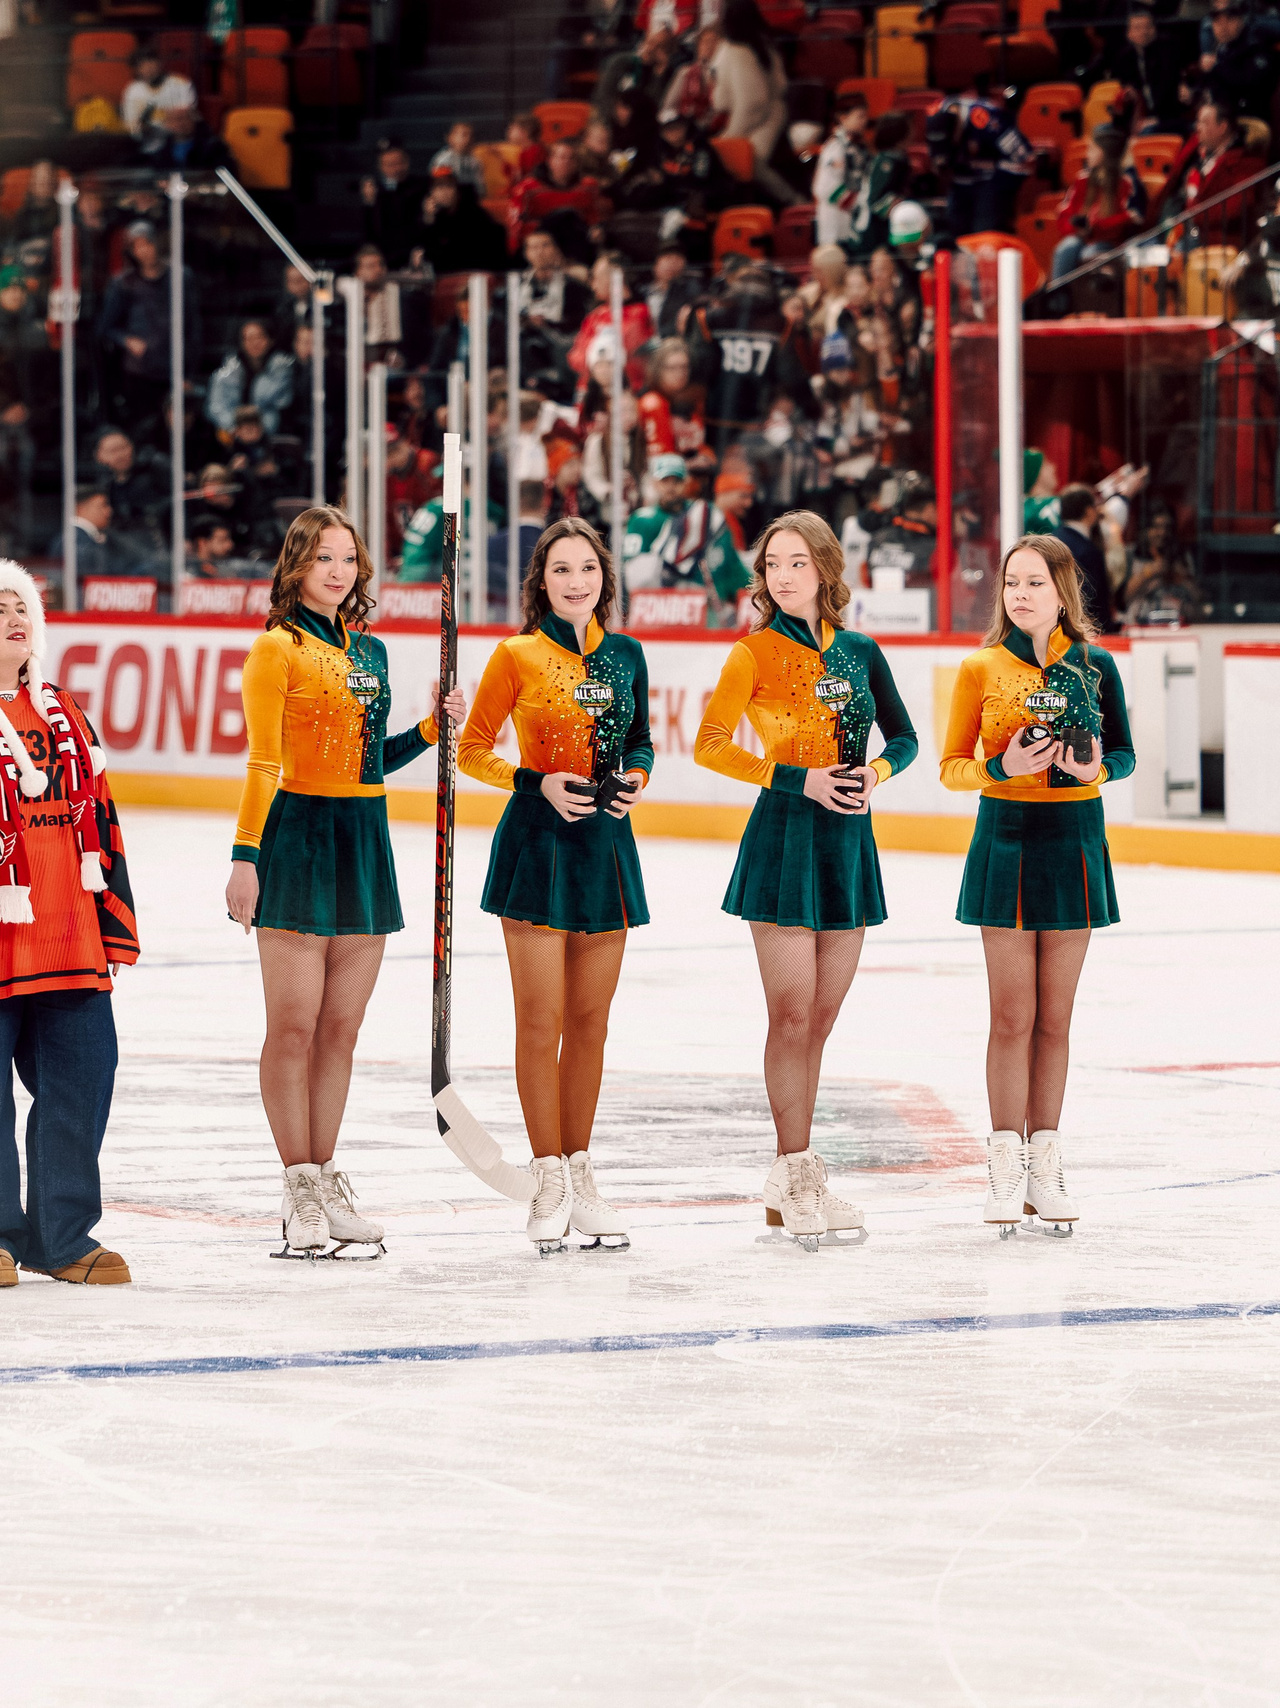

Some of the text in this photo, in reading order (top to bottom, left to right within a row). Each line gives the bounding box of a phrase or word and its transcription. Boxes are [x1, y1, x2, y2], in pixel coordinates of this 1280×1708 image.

[347, 676, 379, 688] ALL STAR
[574, 688, 612, 700] ALL STAR
[815, 681, 851, 697] ALL STAR
[57, 643, 249, 755] FONB
[1024, 697, 1066, 707] ALL STAR
